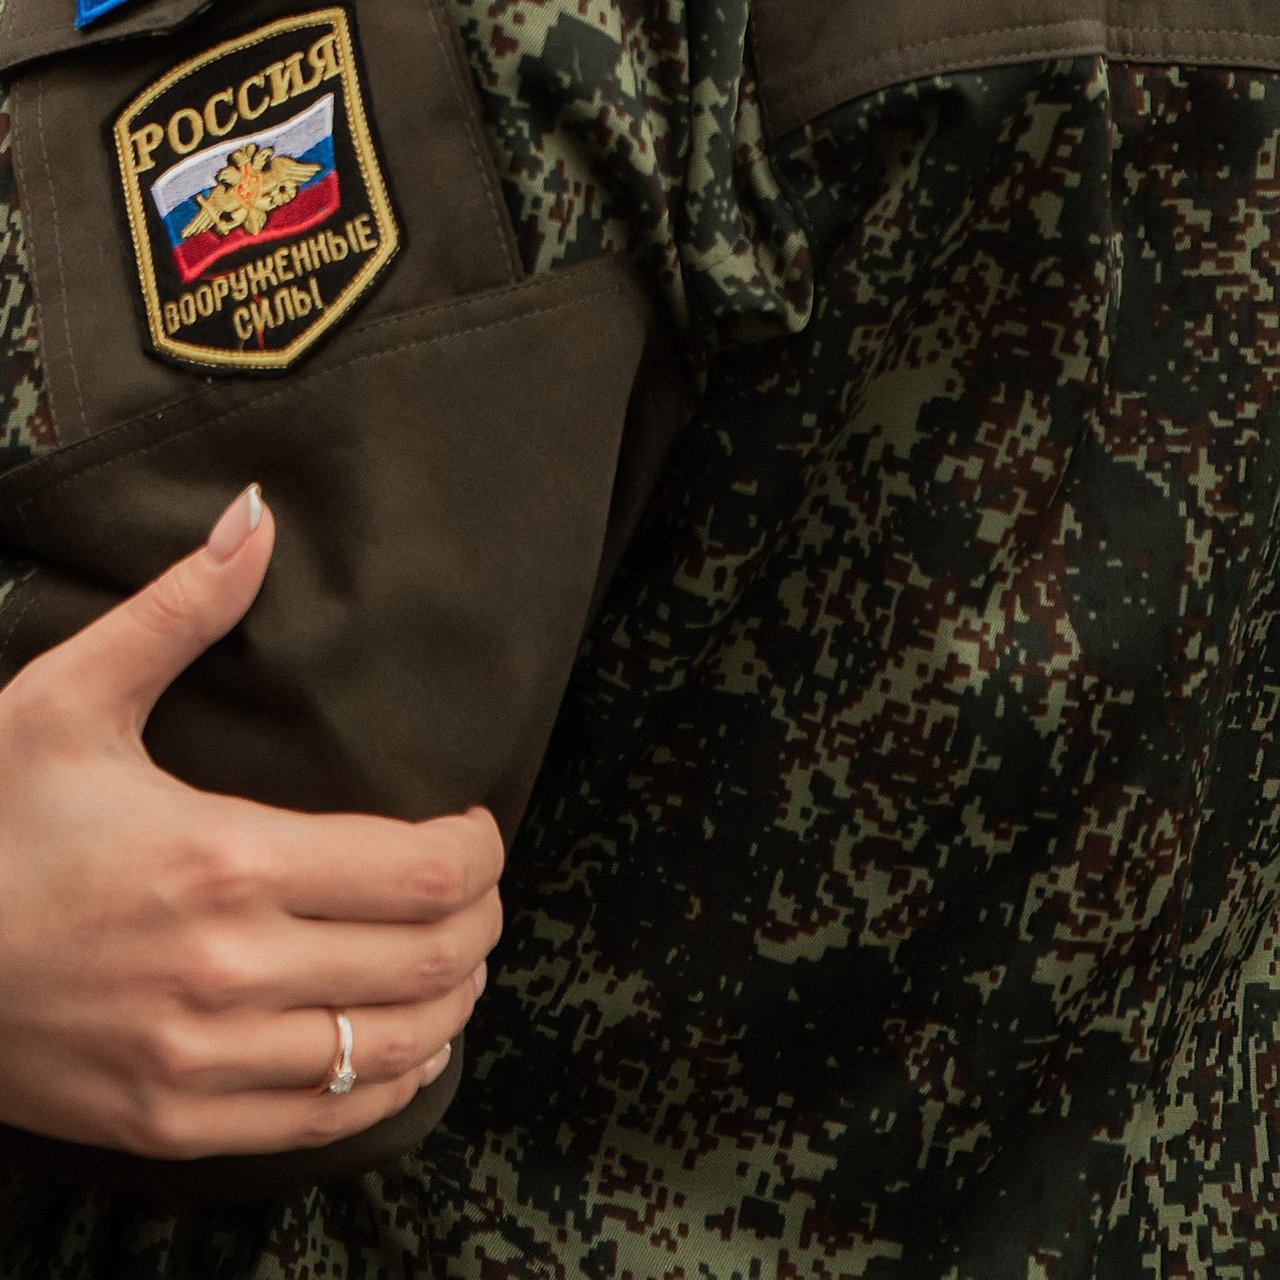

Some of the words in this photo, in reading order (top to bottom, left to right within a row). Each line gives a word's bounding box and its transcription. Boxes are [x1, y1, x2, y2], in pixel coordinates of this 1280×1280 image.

[130, 33, 342, 173] РОССИЯ
[164, 213, 378, 335] ВООРУЖЕННЫЕ
[232, 277, 323, 341] СИЛЫ
